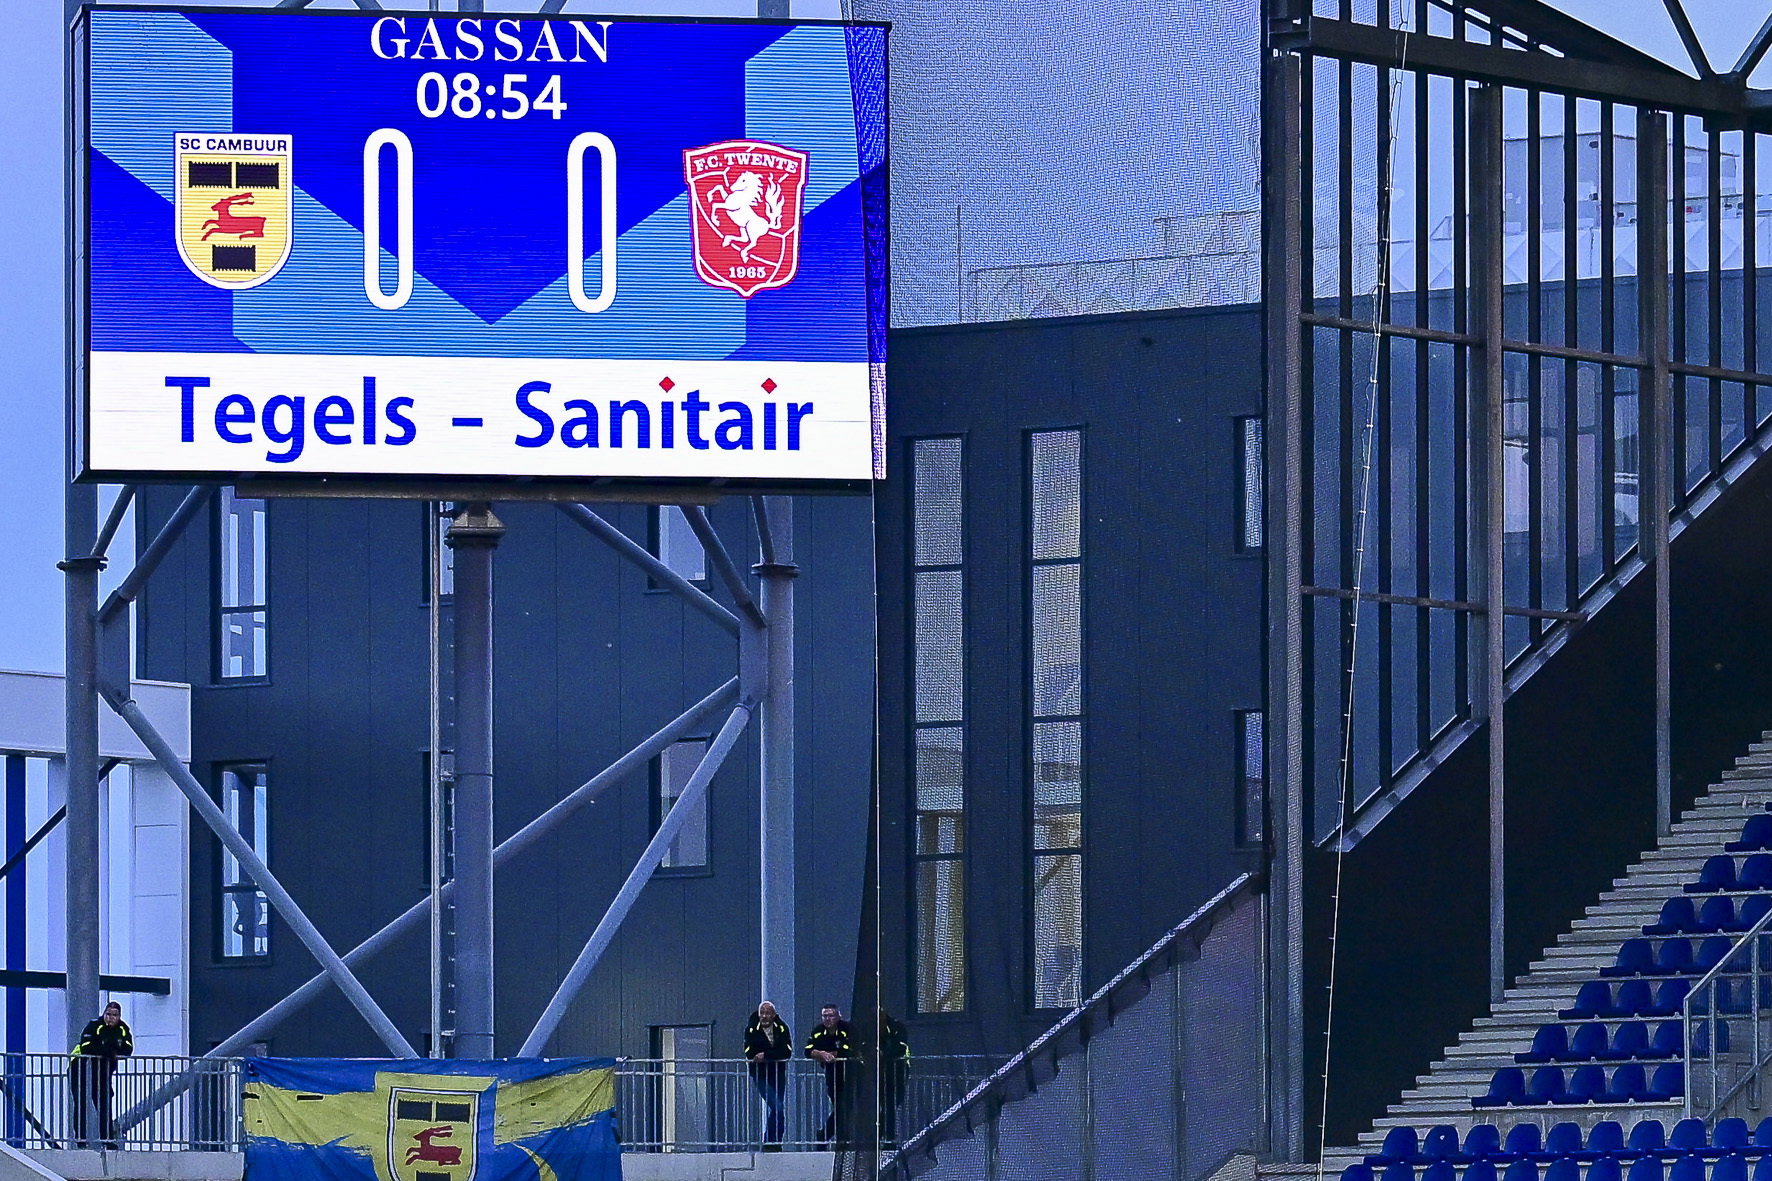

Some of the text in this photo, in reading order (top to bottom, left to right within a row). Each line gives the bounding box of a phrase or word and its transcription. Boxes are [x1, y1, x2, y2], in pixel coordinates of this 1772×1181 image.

[370, 16, 613, 63] GASSAN
[416, 71, 568, 120] 08:54
[180, 138, 288, 152] SC CAMBUUR
[693, 152, 799, 174] F.C. TWENTE
[363, 127, 618, 314] 0 0
[728, 266, 766, 279] 1965
[165, 376, 416, 463] Tegels
[514, 376, 814, 451] Sanitair
